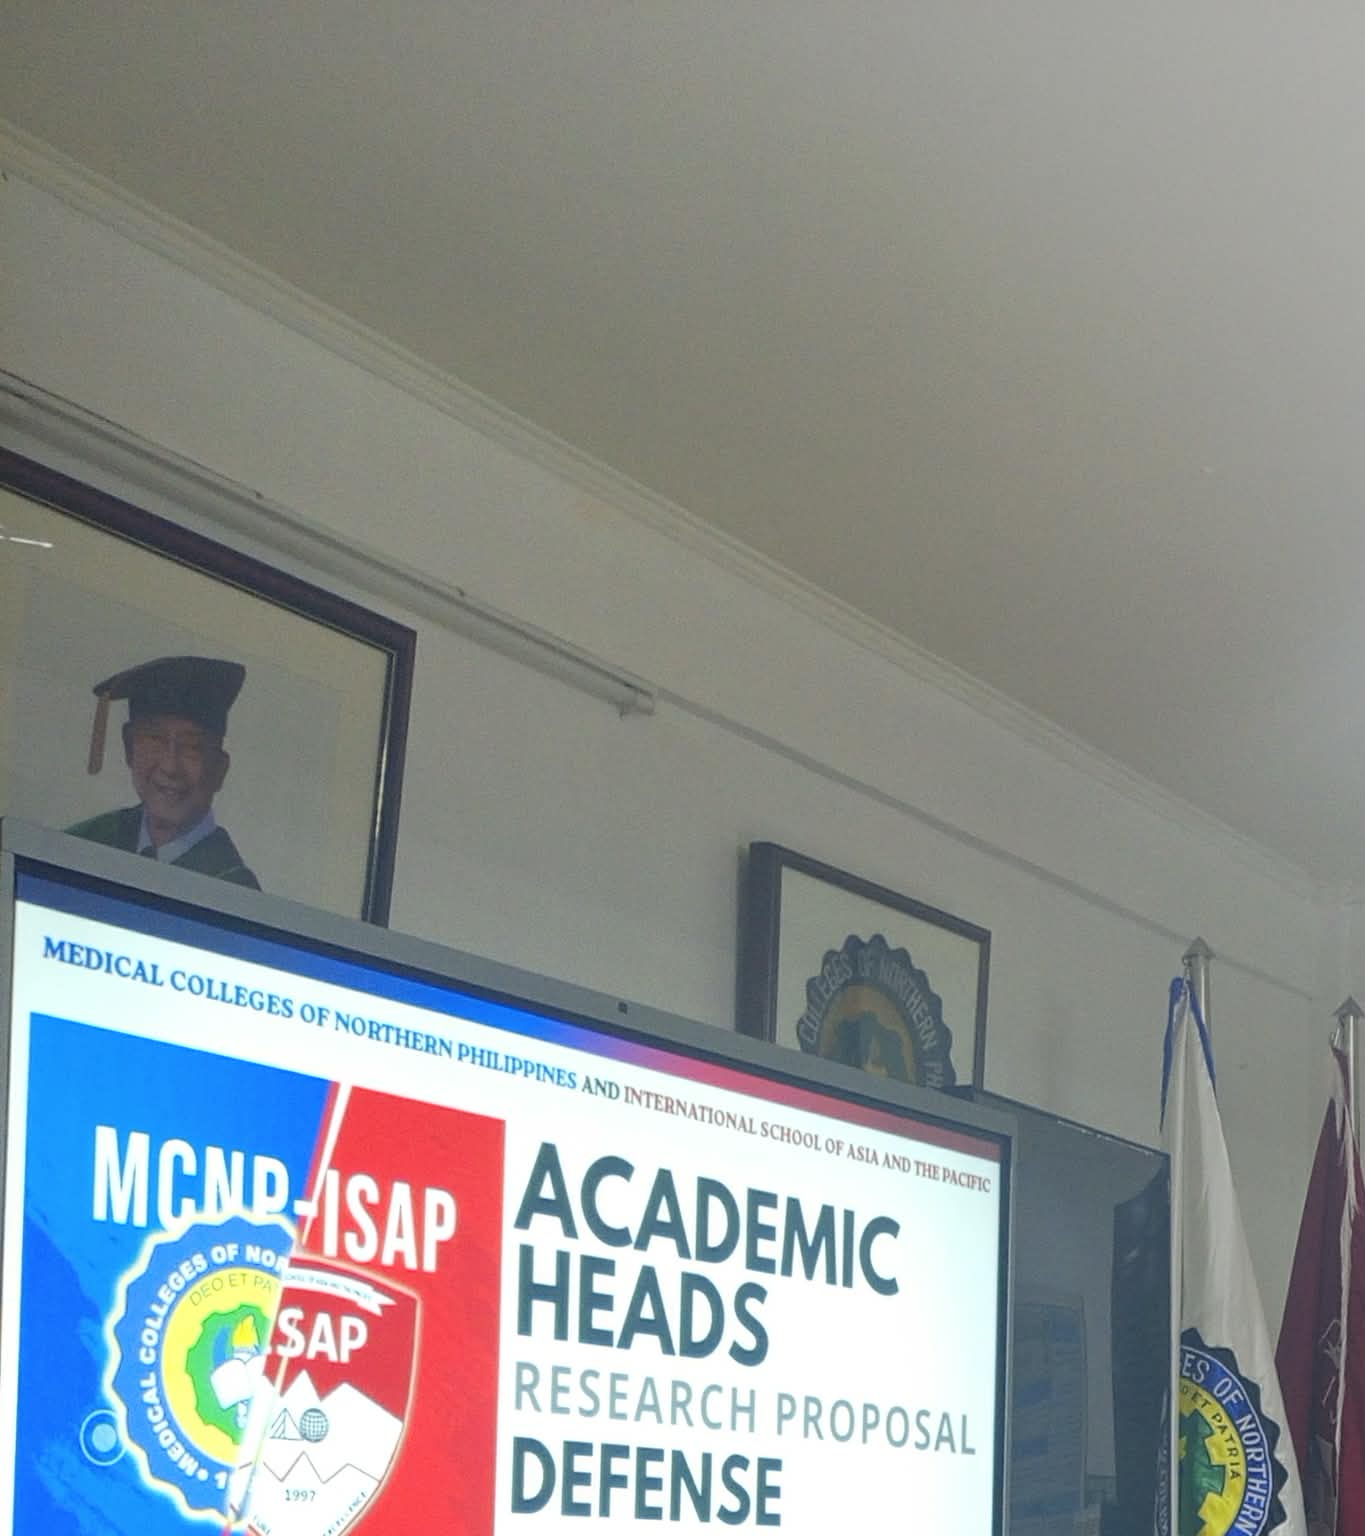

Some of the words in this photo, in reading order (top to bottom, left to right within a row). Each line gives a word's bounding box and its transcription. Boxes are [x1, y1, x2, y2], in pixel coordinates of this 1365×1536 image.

[879, 953, 937, 1051] NORTHERN
[43, 936, 164, 986] MEDICAL
[170, 970, 293, 1018] COLLEGES
[299, 1003, 330, 1027] OF
[334, 1010, 453, 1059] NORTHERN
[457, 1043, 577, 1089] PHILIPPINES
[581, 1076, 620, 1100] AND
[623, 1085, 757, 1136] INTERNATIONAL
[760, 1120, 822, 1152] SCHOOL
[825, 1138, 845, 1156] OF
[846, 1143, 878, 1166] ASIA
[882, 1152, 911, 1173] AND
[914, 1160, 940, 1180] THE
[942, 1167, 992, 1193] PACIFIC
[514, 1141, 901, 1296] ACADEMIC
[139, 1253, 208, 1365] COLLEGES
[210, 1243, 240, 1265] OF
[189, 1275, 224, 1307] DEO
[228, 1273, 248, 1289] ET
[517, 1243, 769, 1367] HEADS
[514, 1361, 756, 1433] RESEARCH
[776, 1392, 976, 1455] PROPOSAL
[1191, 1390, 1210, 1409] ET
[1211, 1412, 1241, 1481] PATRIA
[1214, 1377, 1244, 1407] OF
[285, 1488, 317, 1502] 1997
[511, 1435, 784, 1527] DEFENSE
